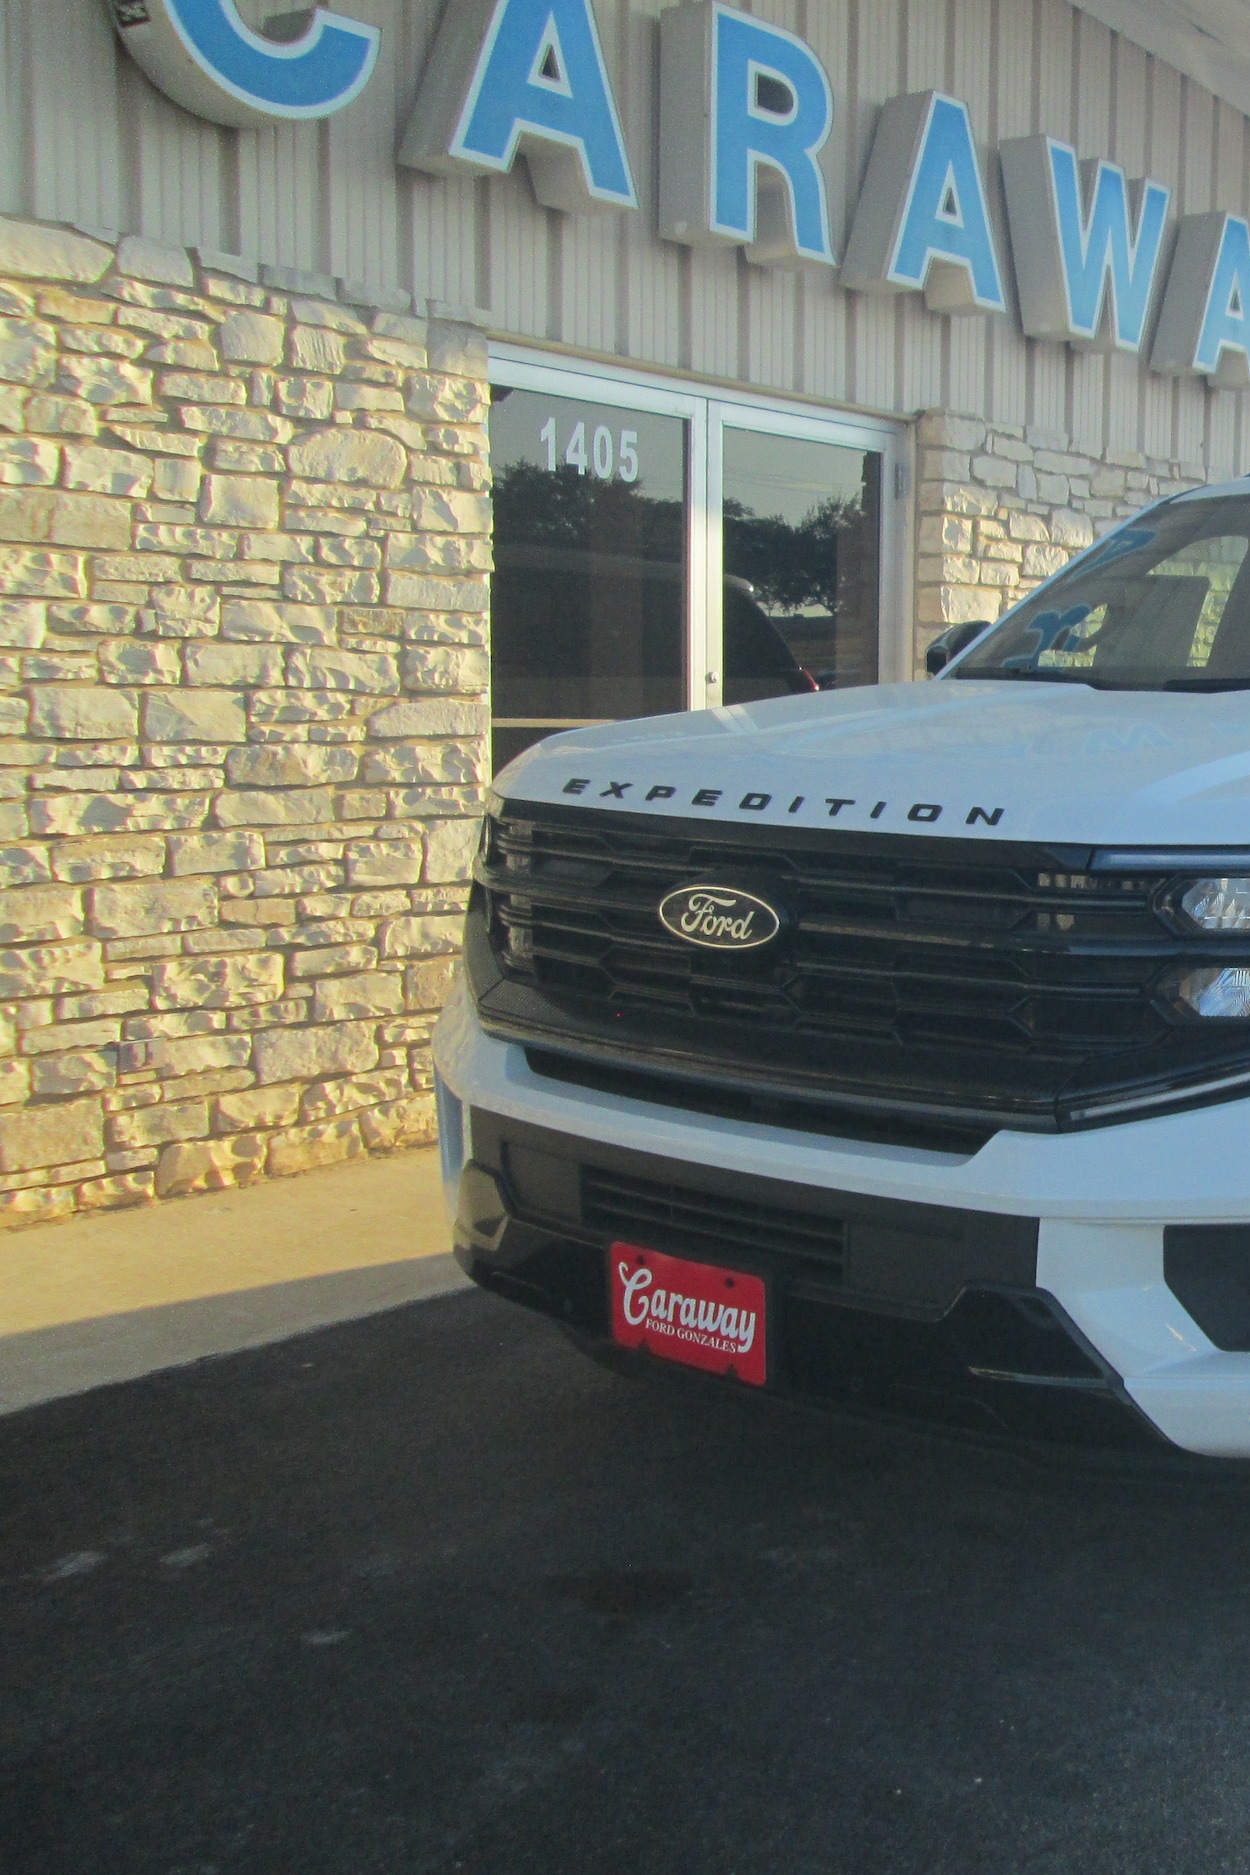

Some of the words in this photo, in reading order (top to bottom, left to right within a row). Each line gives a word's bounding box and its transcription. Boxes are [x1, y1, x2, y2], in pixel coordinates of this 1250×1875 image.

[539, 416, 640, 483] 1405
[562, 777, 1006, 827] EXPEDITION
[680, 893, 756, 941] Ford
[618, 1261, 756, 1353] Caraway
[645, 1318, 676, 1337] FORD
[676, 1327, 738, 1354] GONZALES
